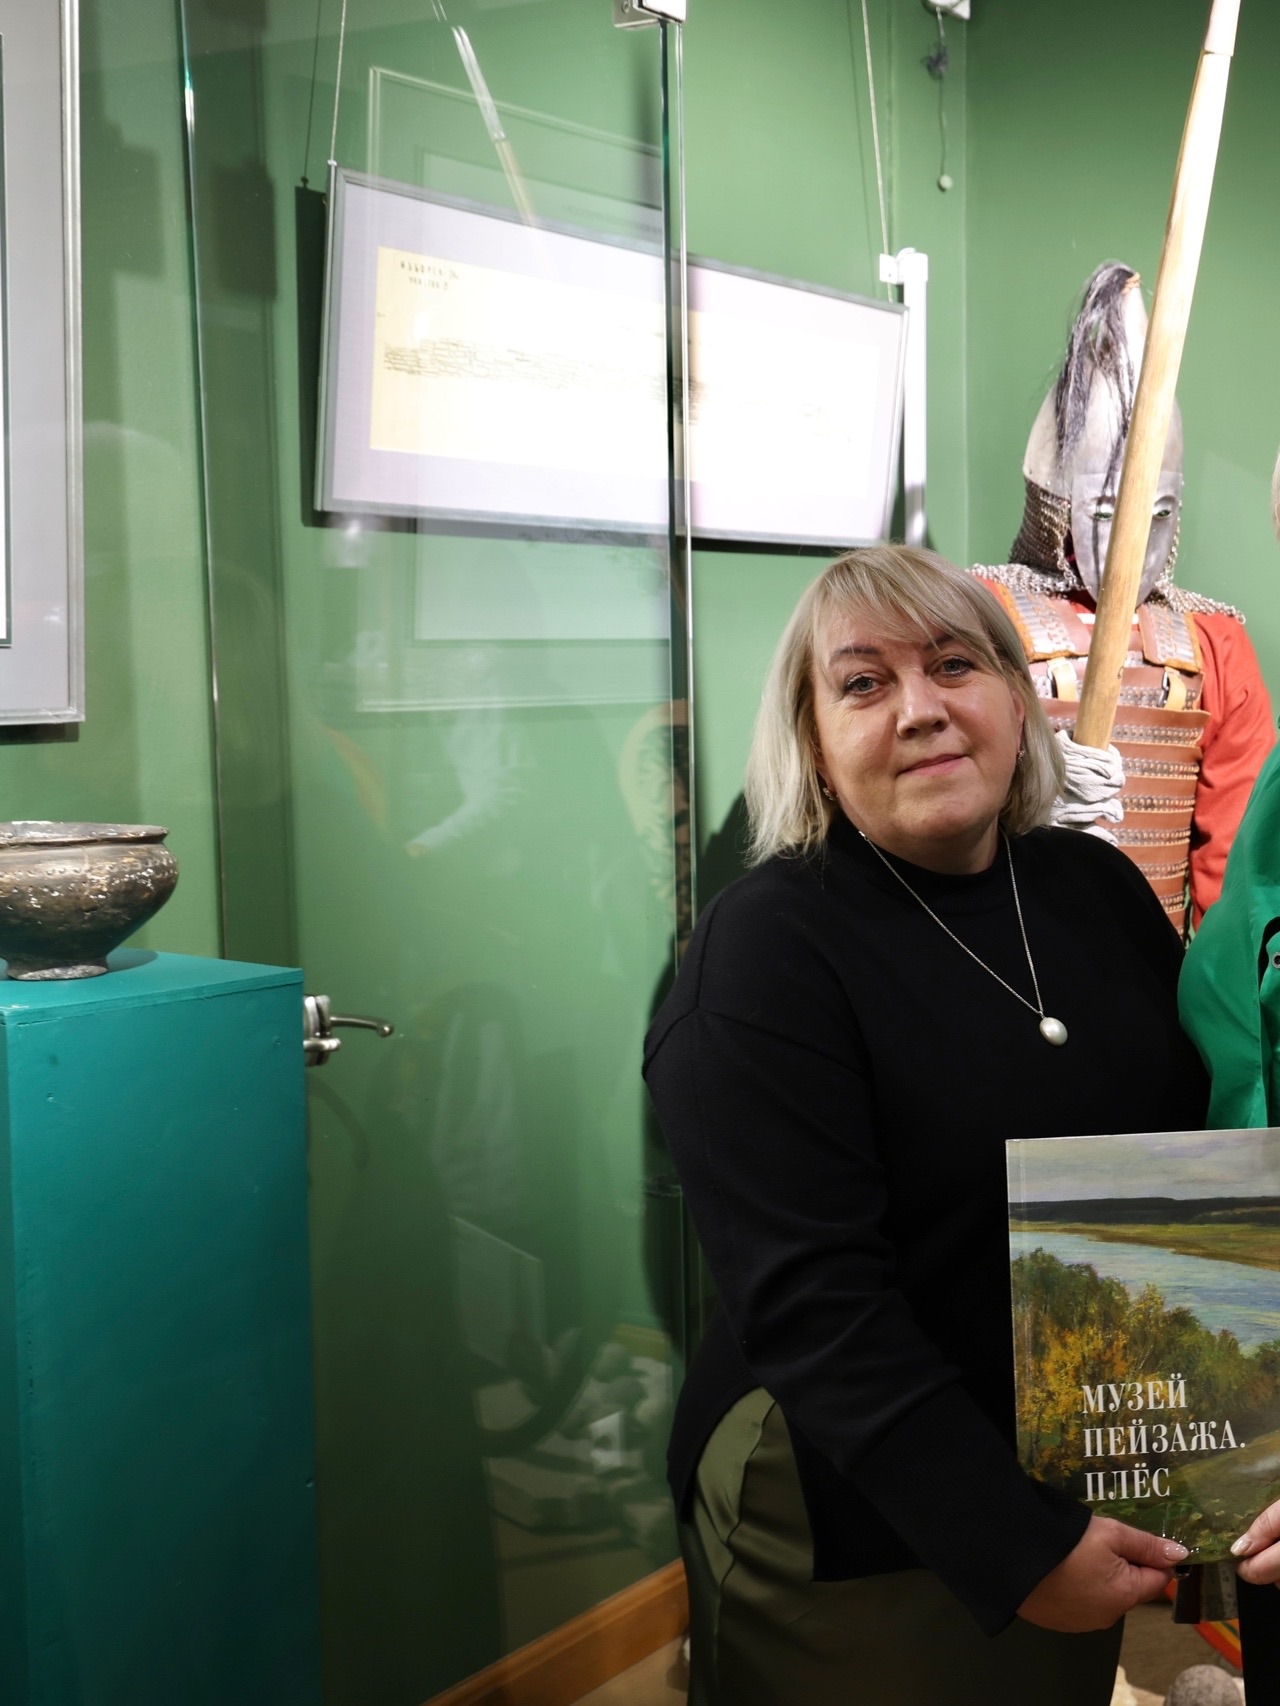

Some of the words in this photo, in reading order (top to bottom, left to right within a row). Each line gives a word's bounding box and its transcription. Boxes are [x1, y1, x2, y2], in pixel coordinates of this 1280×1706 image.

[1083, 1373, 1187, 1414] МУЗЕЙ
[1084, 1419, 1246, 1458] ПЕЙЗАЖА.
[1085, 1463, 1170, 1501] ПЛЁС
